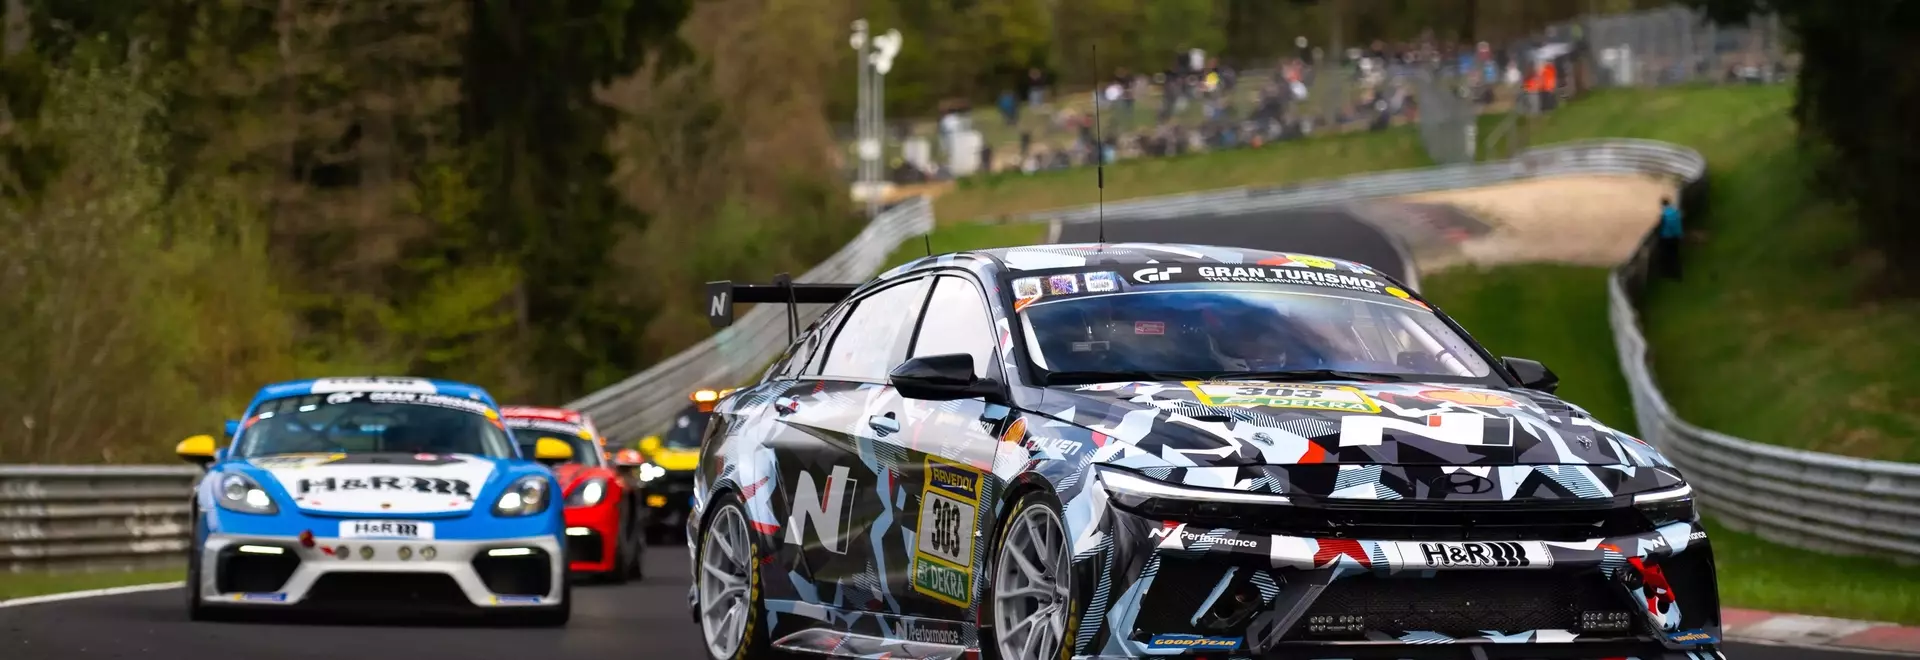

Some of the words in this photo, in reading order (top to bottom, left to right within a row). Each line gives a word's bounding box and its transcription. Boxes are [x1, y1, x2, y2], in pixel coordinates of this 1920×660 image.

[1198, 266, 1266, 278] GRAN
[1264, 277, 1313, 285] DRIVING
[1315, 281, 1382, 294] SIMULATOR
[710, 292, 726, 317] N
[1235, 386, 1324, 399] 303
[1268, 398, 1369, 412] DEKRA
[299, 476, 403, 495] H&R
[933, 466, 974, 493] RAVENOL
[783, 464, 858, 555] N
[354, 522, 393, 535] H&R
[931, 498, 961, 558] 303
[1181, 531, 1258, 548] Performance
[1421, 542, 1493, 568] H&R
[930, 565, 966, 600] DEKRA
[911, 624, 959, 644] Performance
[1154, 638, 1237, 646] GOODYEAR
